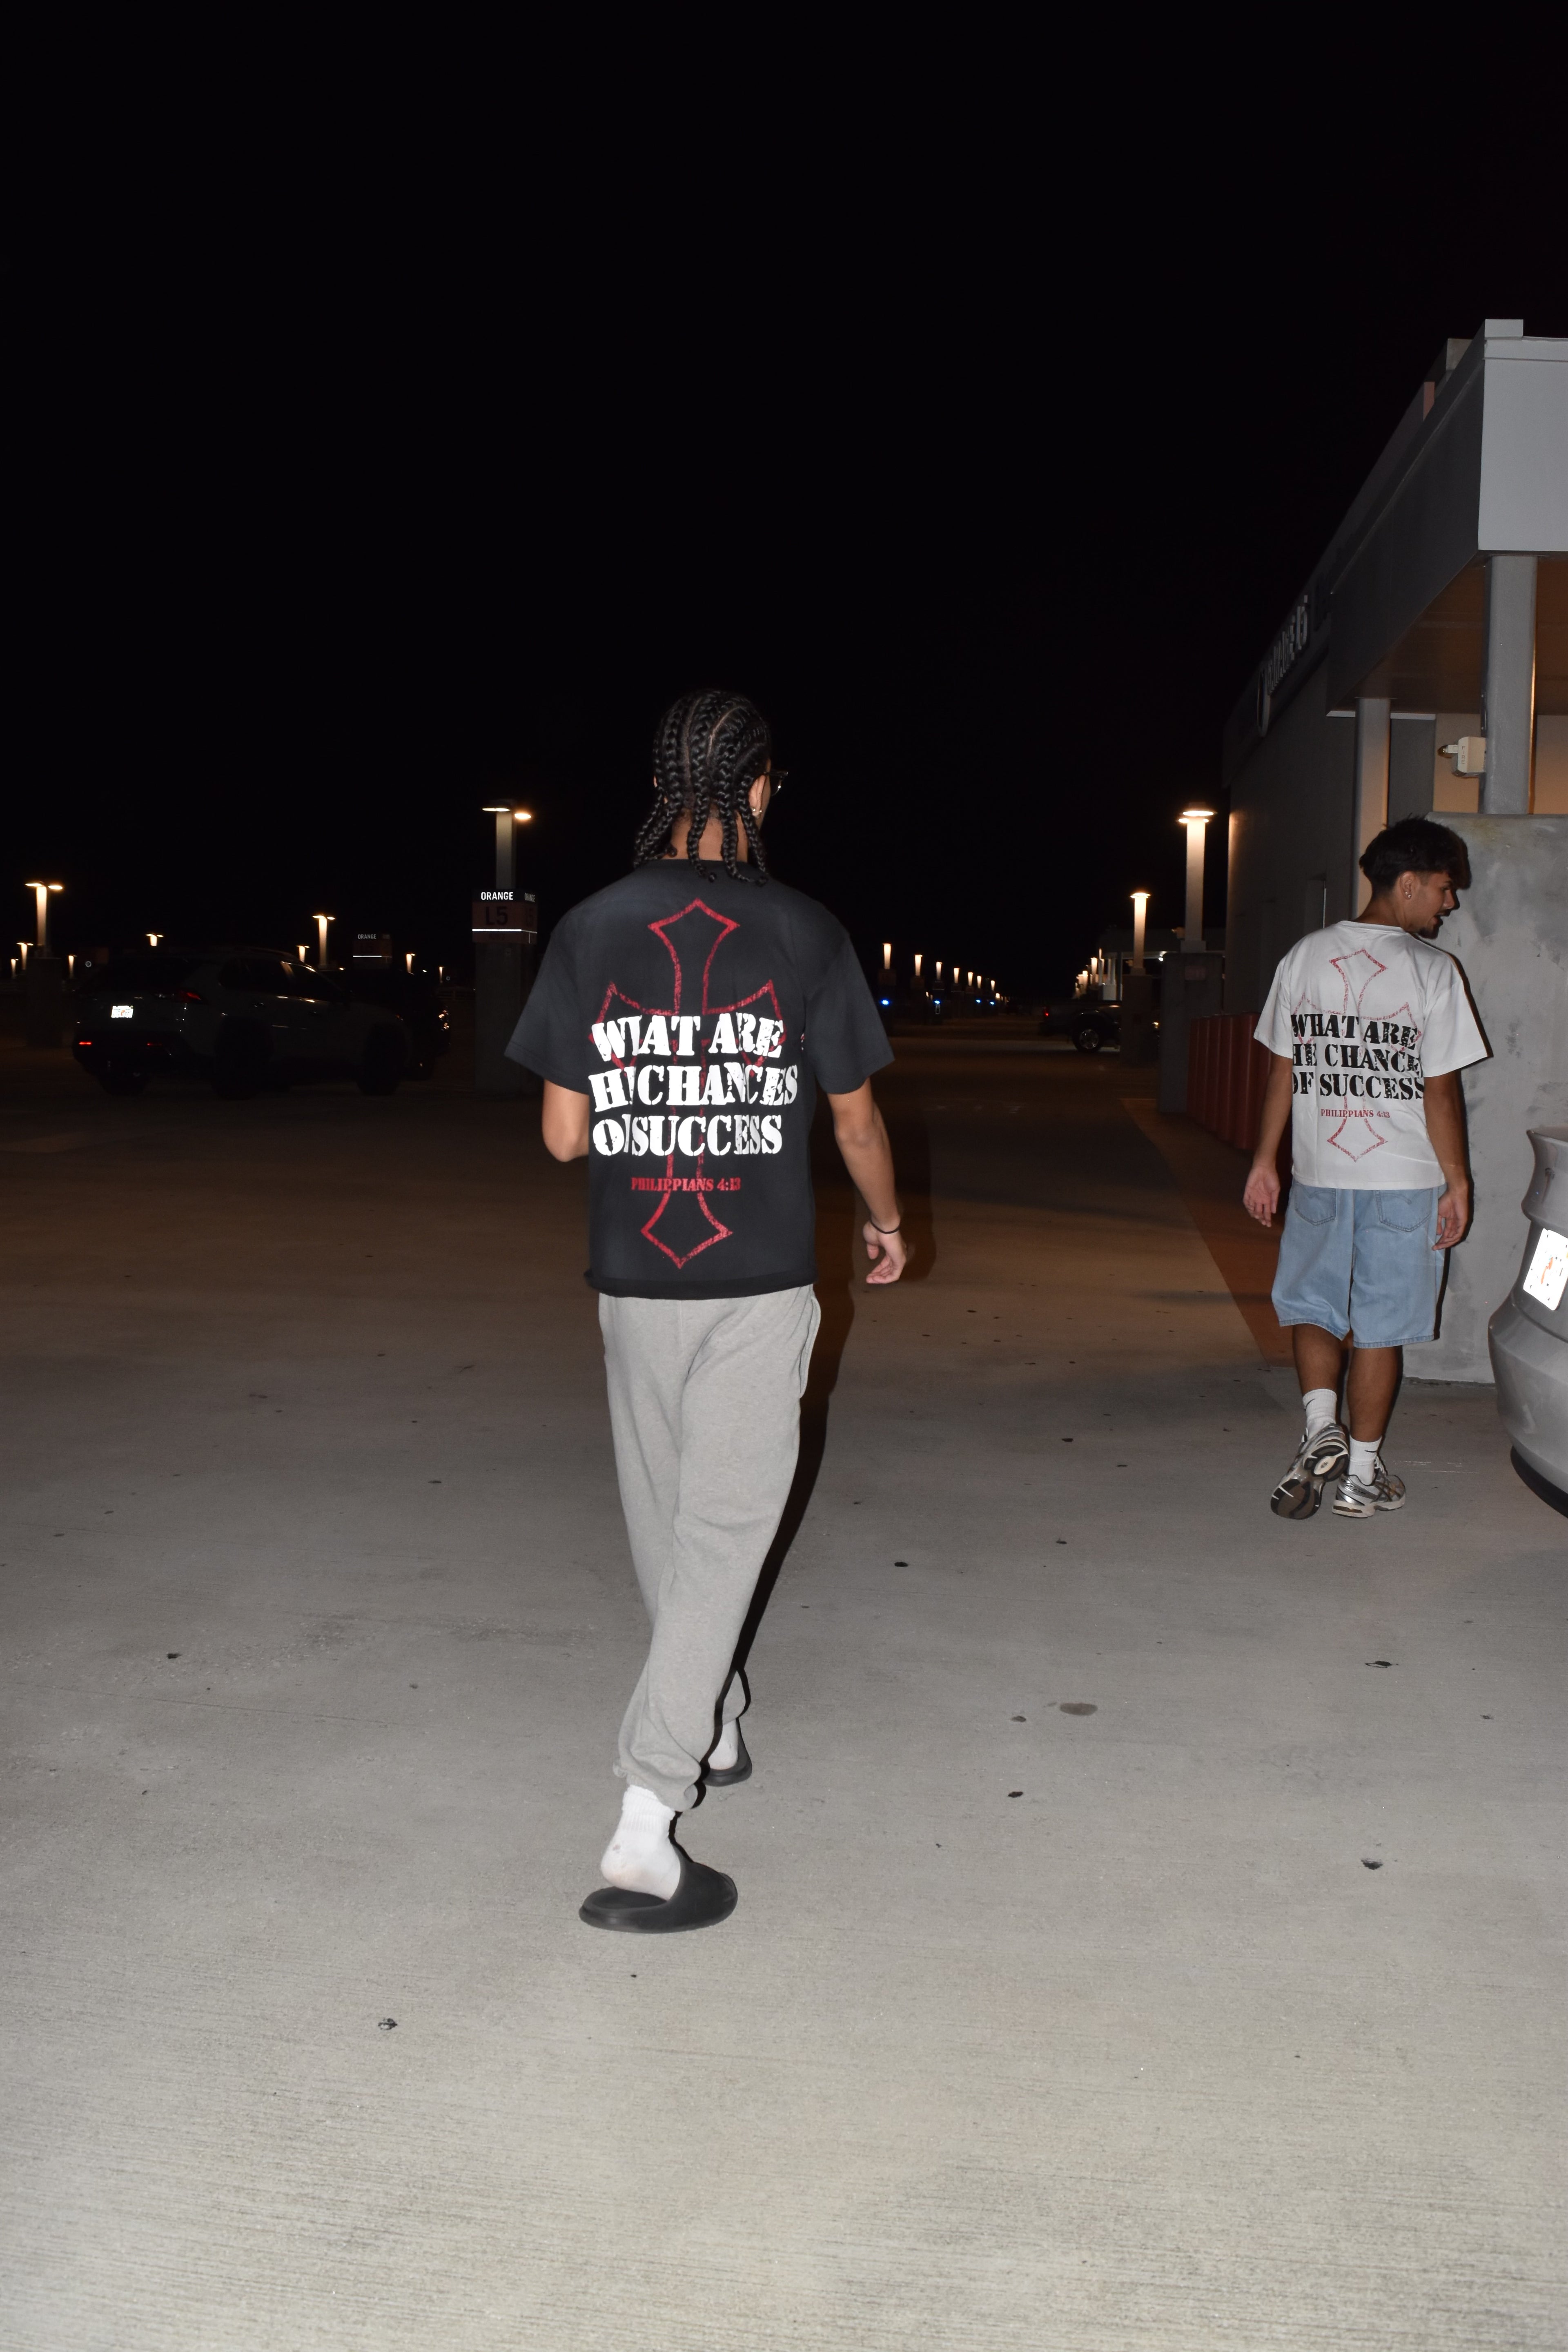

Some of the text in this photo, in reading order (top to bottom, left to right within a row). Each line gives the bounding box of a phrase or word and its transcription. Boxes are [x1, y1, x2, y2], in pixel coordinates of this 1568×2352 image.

[481, 892, 513, 900] ORANGE
[524, 893, 535, 902] ORANGE
[486, 906, 508, 925] L5
[708, 1012, 784, 1058] ARE
[1291, 1014, 1417, 1050] WHAT ARE
[637, 1062, 798, 1105] CHANCES
[1319, 1074, 1424, 1100] SUCCESS
[1321, 1109, 1374, 1118] PHILIPPIANS
[632, 1115, 782, 1156] SUCCESS
[631, 1178, 741, 1191] PHILIPPIANS 4:13
